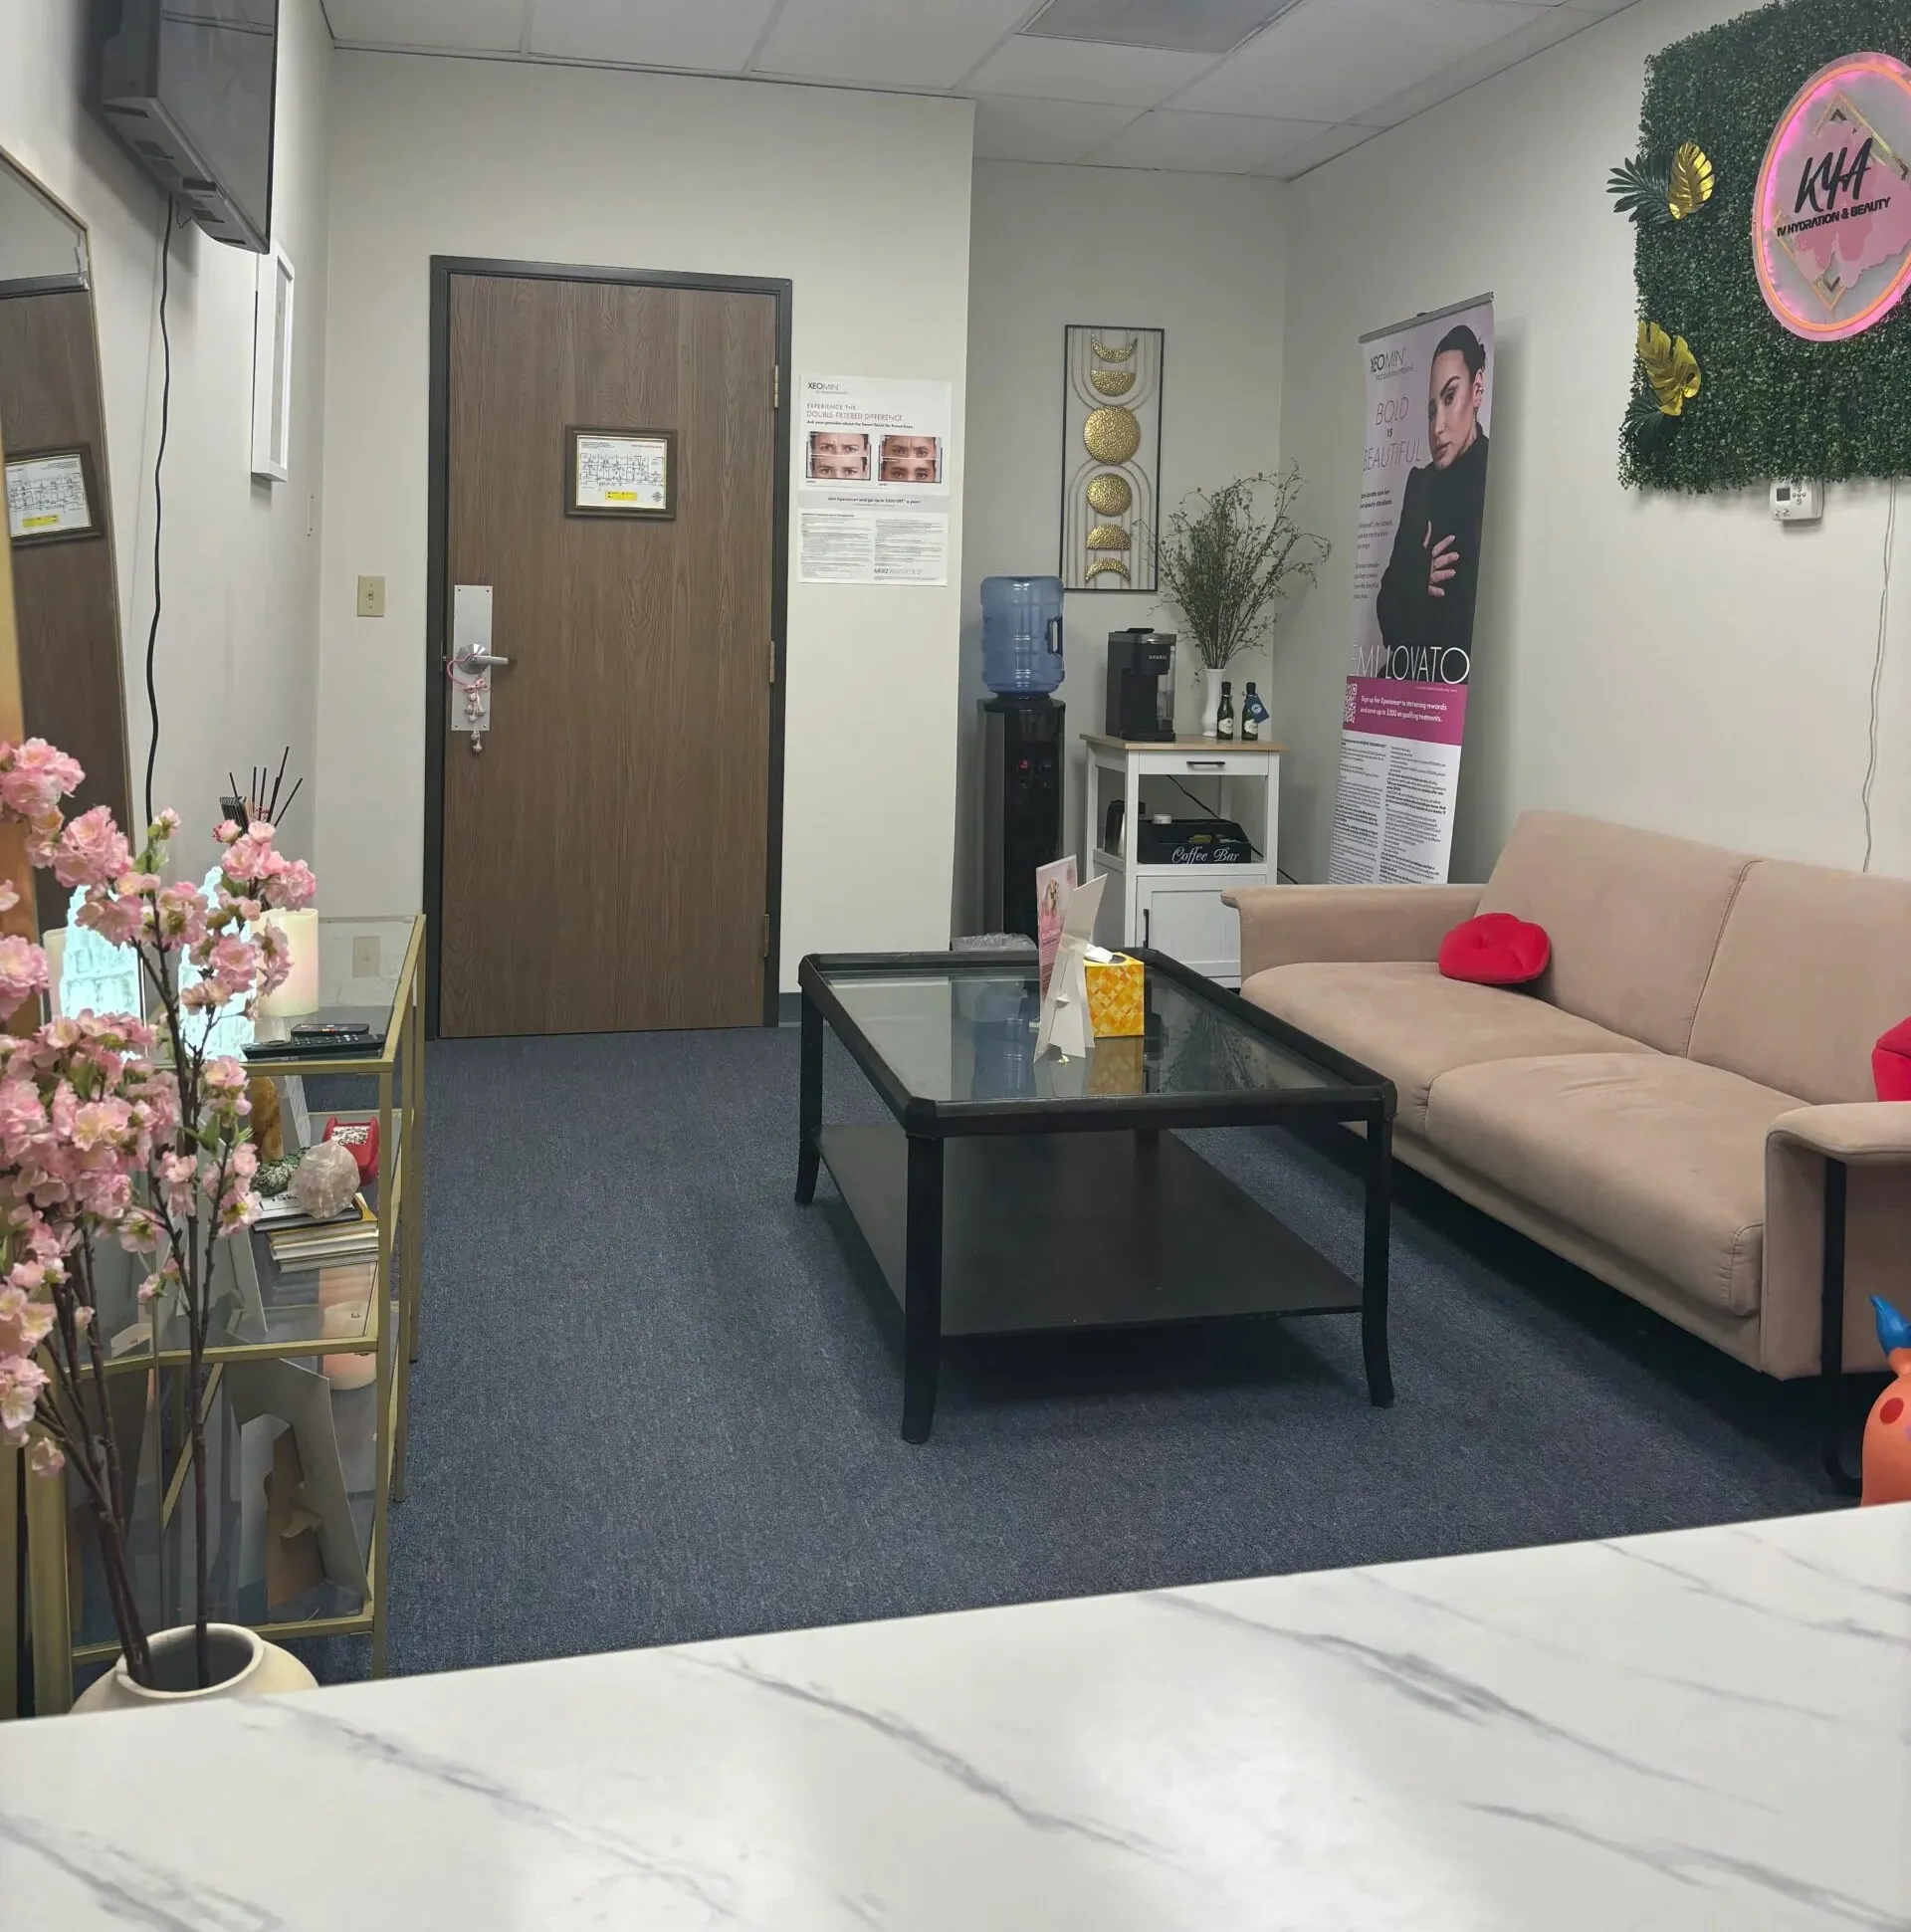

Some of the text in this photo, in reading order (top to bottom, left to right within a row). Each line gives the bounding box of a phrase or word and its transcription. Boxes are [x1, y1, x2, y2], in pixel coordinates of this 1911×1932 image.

[1794, 137, 1873, 214] KYA
[1777, 197, 1891, 237] IV HYDRATION & BEAUTY
[1370, 349, 1405, 373] XEOMIN
[808, 382, 839, 391] XEOMIN
[807, 411, 903, 422] DOUBLE-FILTERED DIFFERENCE
[1376, 397, 1409, 426] BOLD
[1363, 438, 1420, 472] BEAUTIFUL
[1385, 645, 1471, 684] LOVATO
[1172, 846, 1240, 864] Coffee Bar
